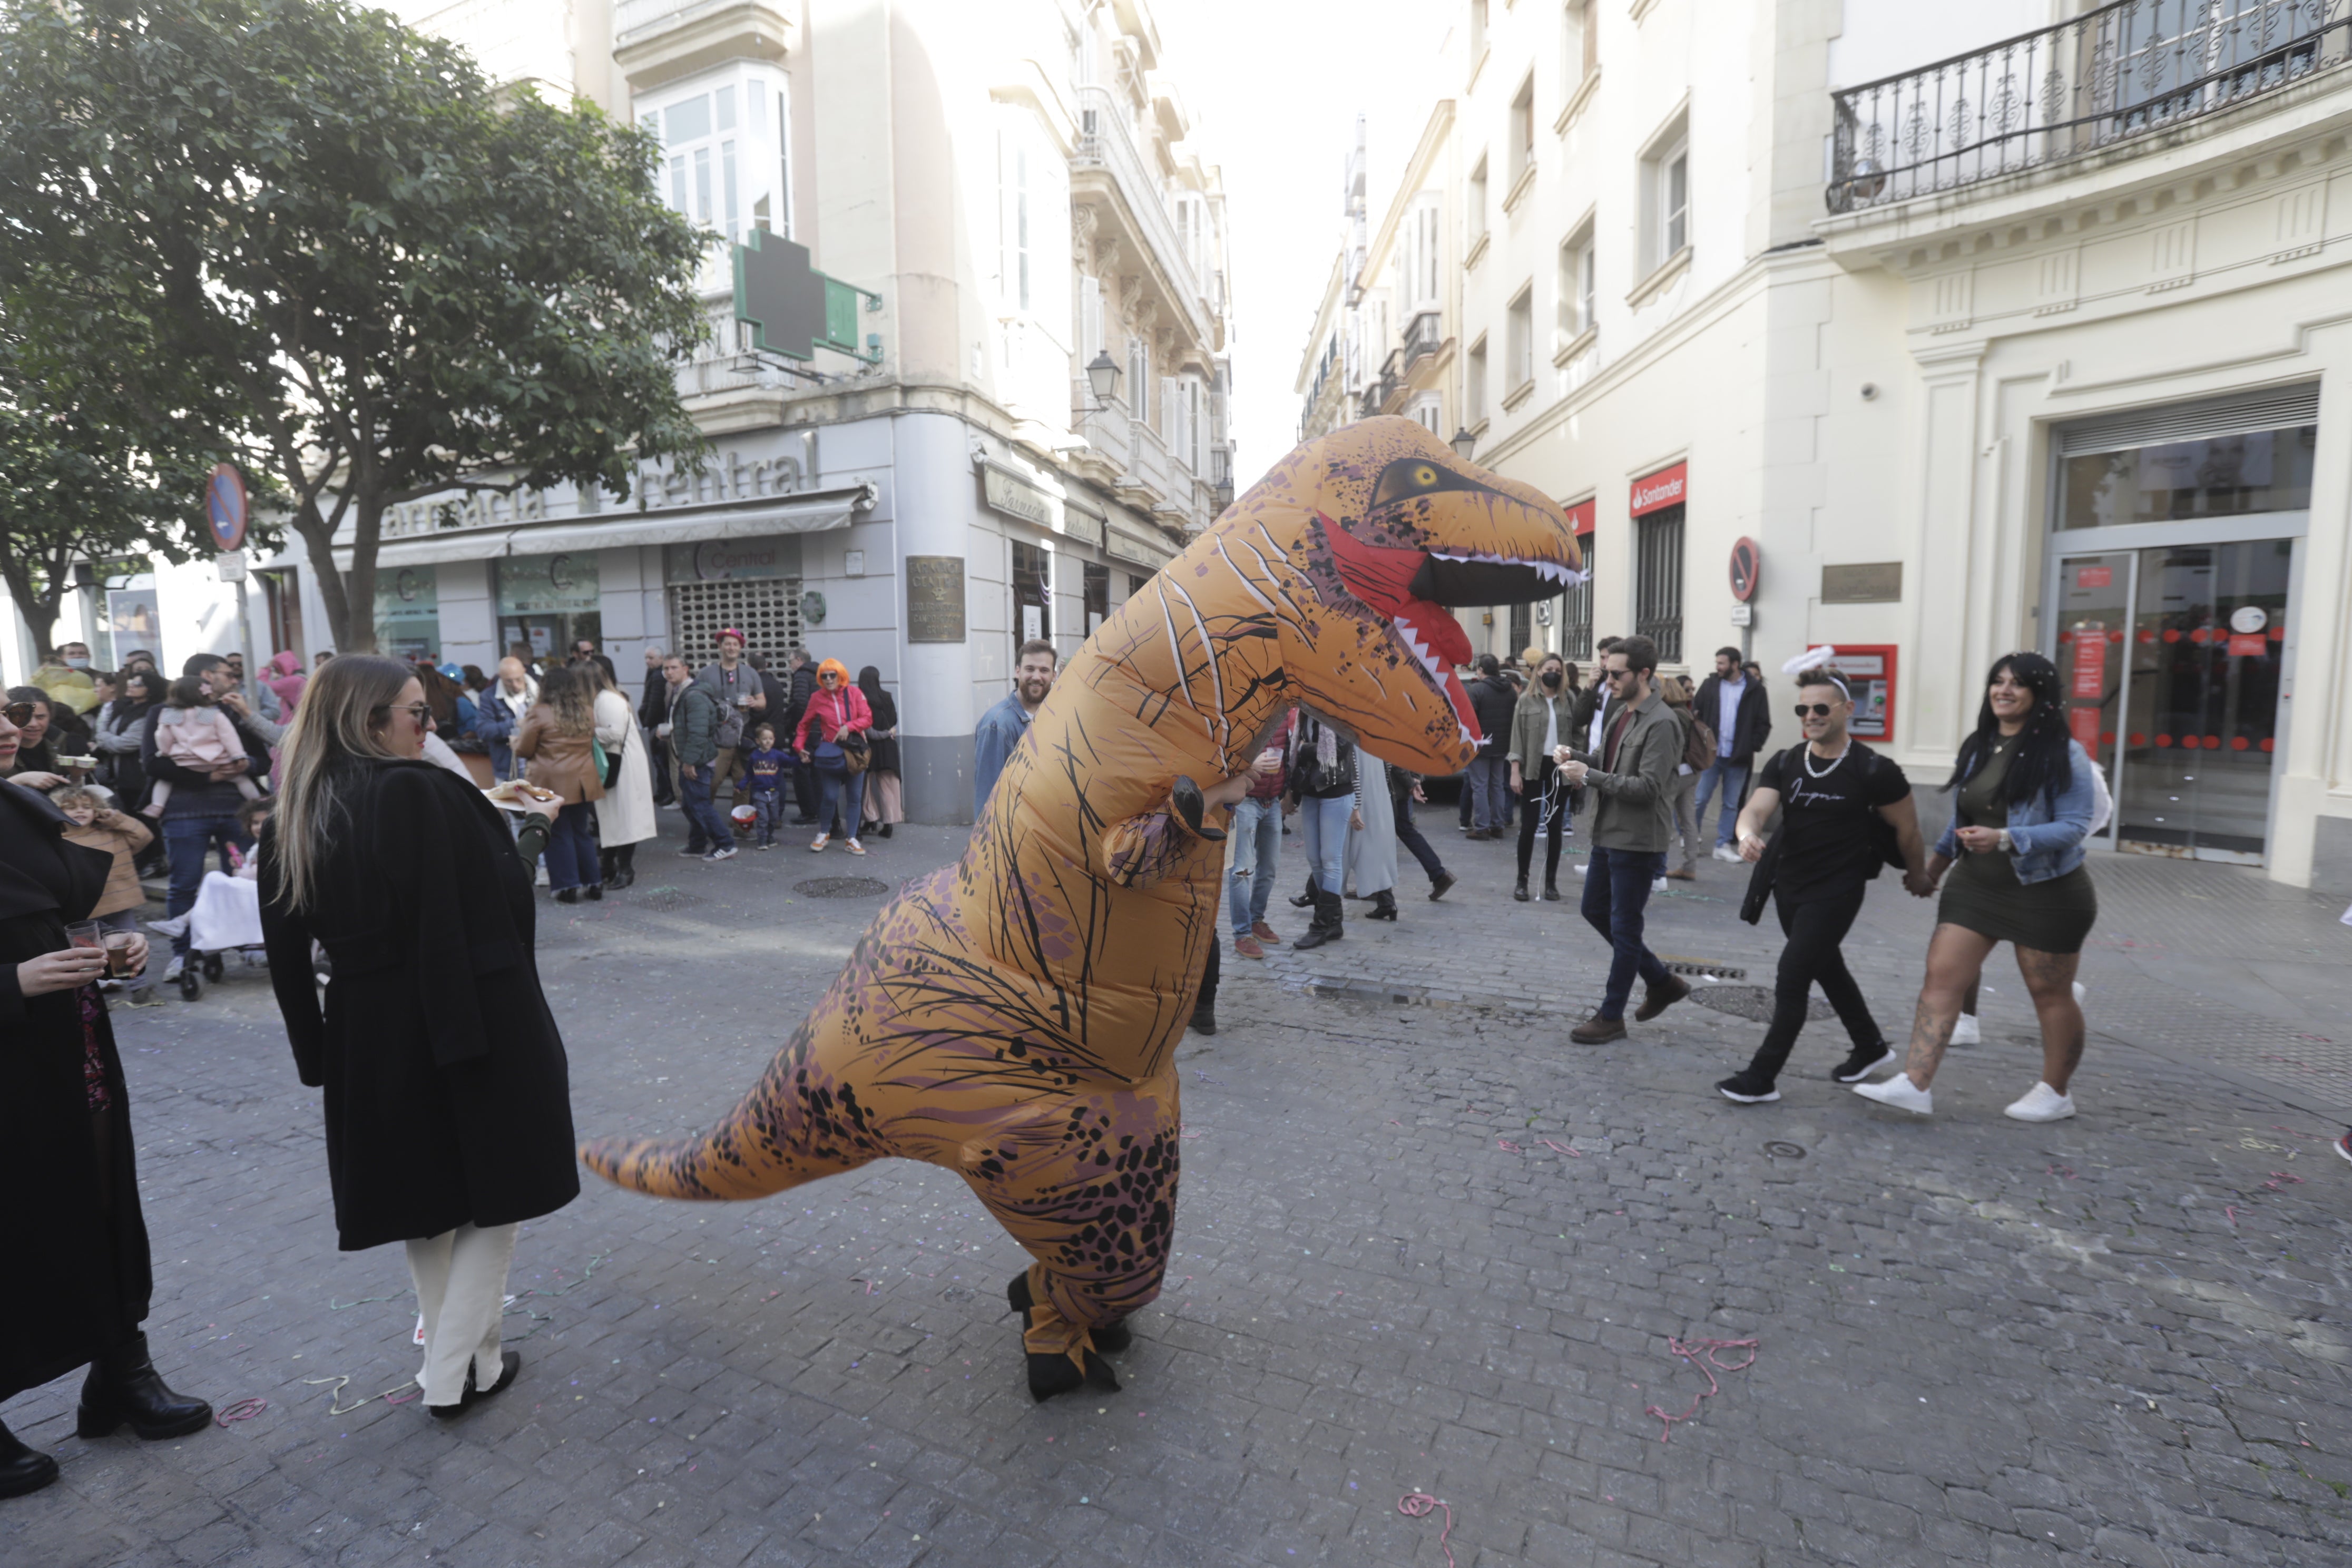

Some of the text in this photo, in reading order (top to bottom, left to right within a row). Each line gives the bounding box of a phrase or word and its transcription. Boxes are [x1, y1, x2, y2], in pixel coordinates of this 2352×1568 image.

[383, 430, 818, 536] armacia central
[1001, 479, 1045, 519] Farmacia
[1642, 478, 1683, 506] Santander
[711, 548, 776, 569] Central
